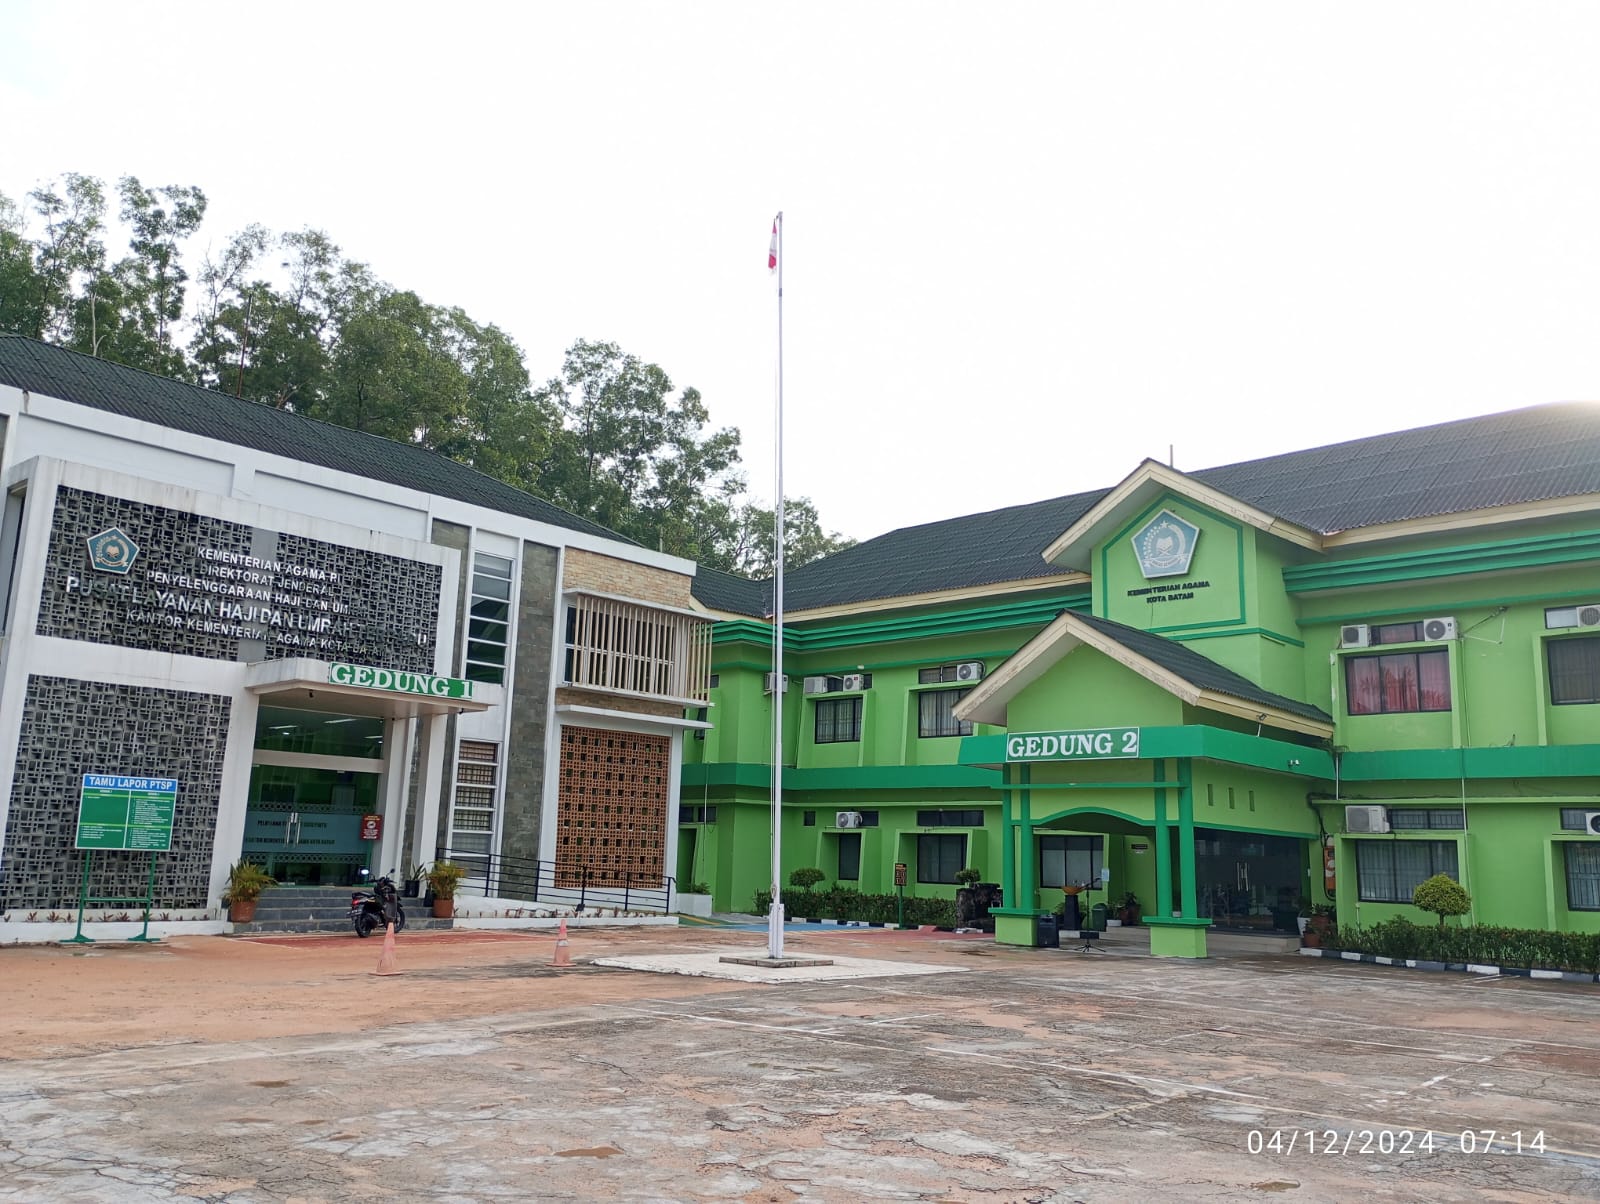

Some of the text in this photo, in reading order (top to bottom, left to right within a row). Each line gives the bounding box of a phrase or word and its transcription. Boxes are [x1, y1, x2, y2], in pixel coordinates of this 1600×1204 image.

[197, 546, 281, 572] KEMENTERIAN
[285, 564, 326, 581] AGAMA
[200, 563, 334, 597] DIREKTORAT JENDERAL
[146, 570, 271, 602] PENYELENGGARAAN
[275, 591, 301, 607] HAJI
[305, 598, 329, 612] DAN
[1146, 592, 1194, 604] KOTA BATAM
[1181, 580, 1210, 591] AGAMA
[132, 585, 215, 616] LAYANAN
[220, 601, 257, 622] HAJI
[260, 607, 294, 628] DAN
[126, 609, 182, 628] KANTOR
[321, 639, 349, 652] KOTA
[331, 664, 473, 699] GEDUNG 1
[1008, 731, 1138, 757] GEDUNG 2
[89, 776, 173, 790] TAMU LAPOR PTSP
